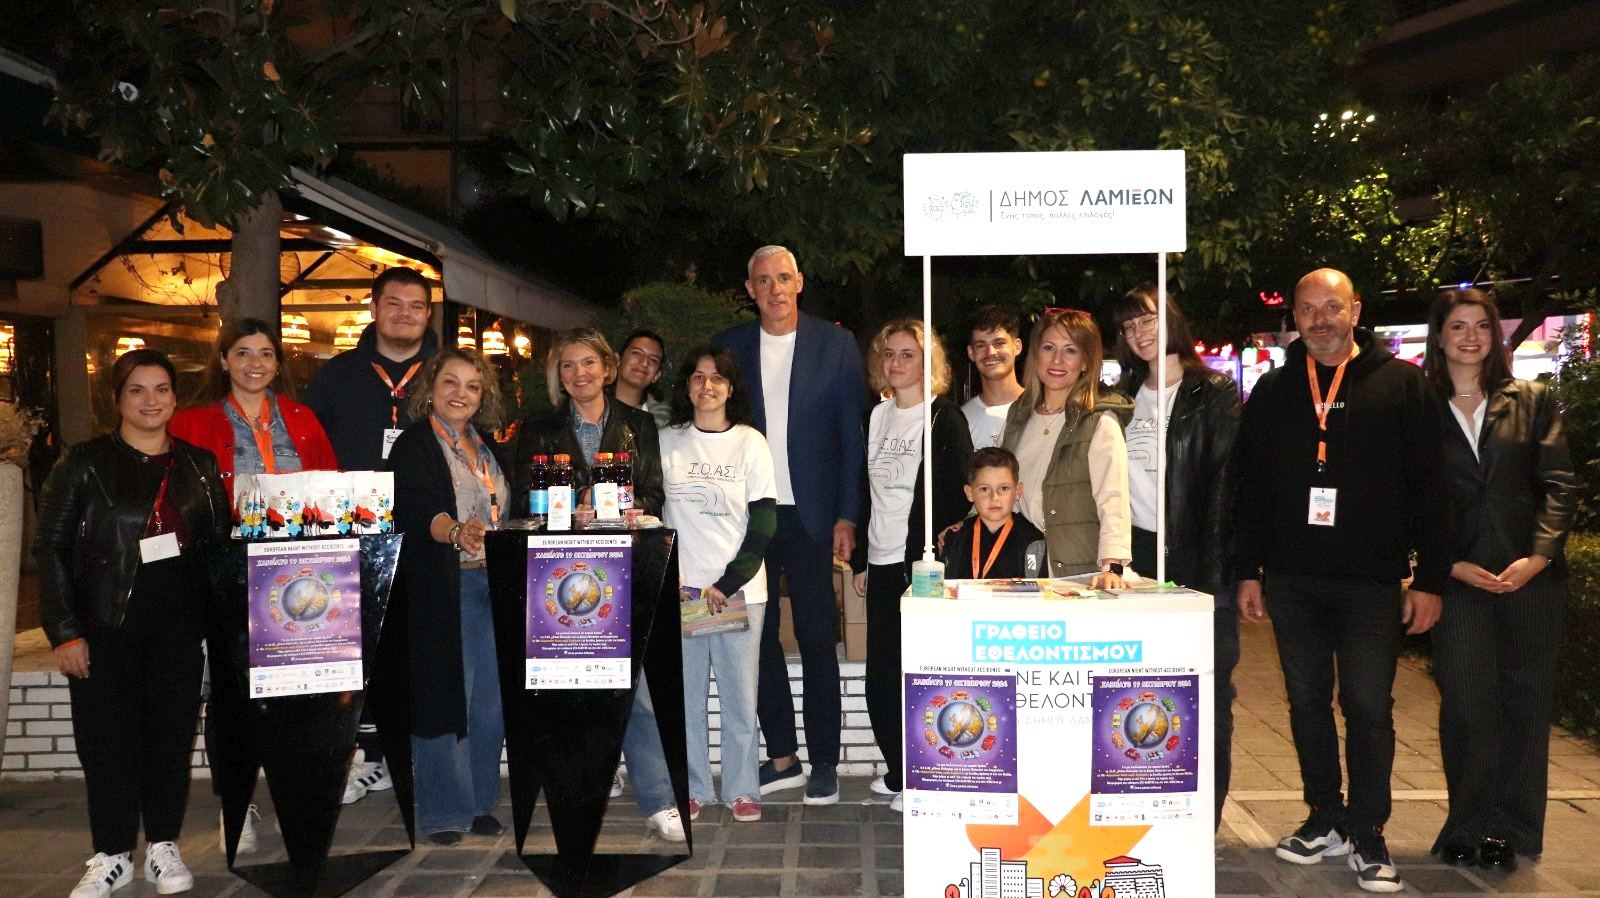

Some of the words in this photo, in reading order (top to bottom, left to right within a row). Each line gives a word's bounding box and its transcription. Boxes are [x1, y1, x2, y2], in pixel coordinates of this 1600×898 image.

[1000, 190, 1069, 207] ΔΗΜΟΣ
[1080, 188, 1173, 206] ΛΑΜΙΕΩΝ
[975, 644, 1138, 661] ΕΘΕΛΟΝΤΙΣΜΟΥ
[1049, 670, 1080, 686] ΚΑΙ
